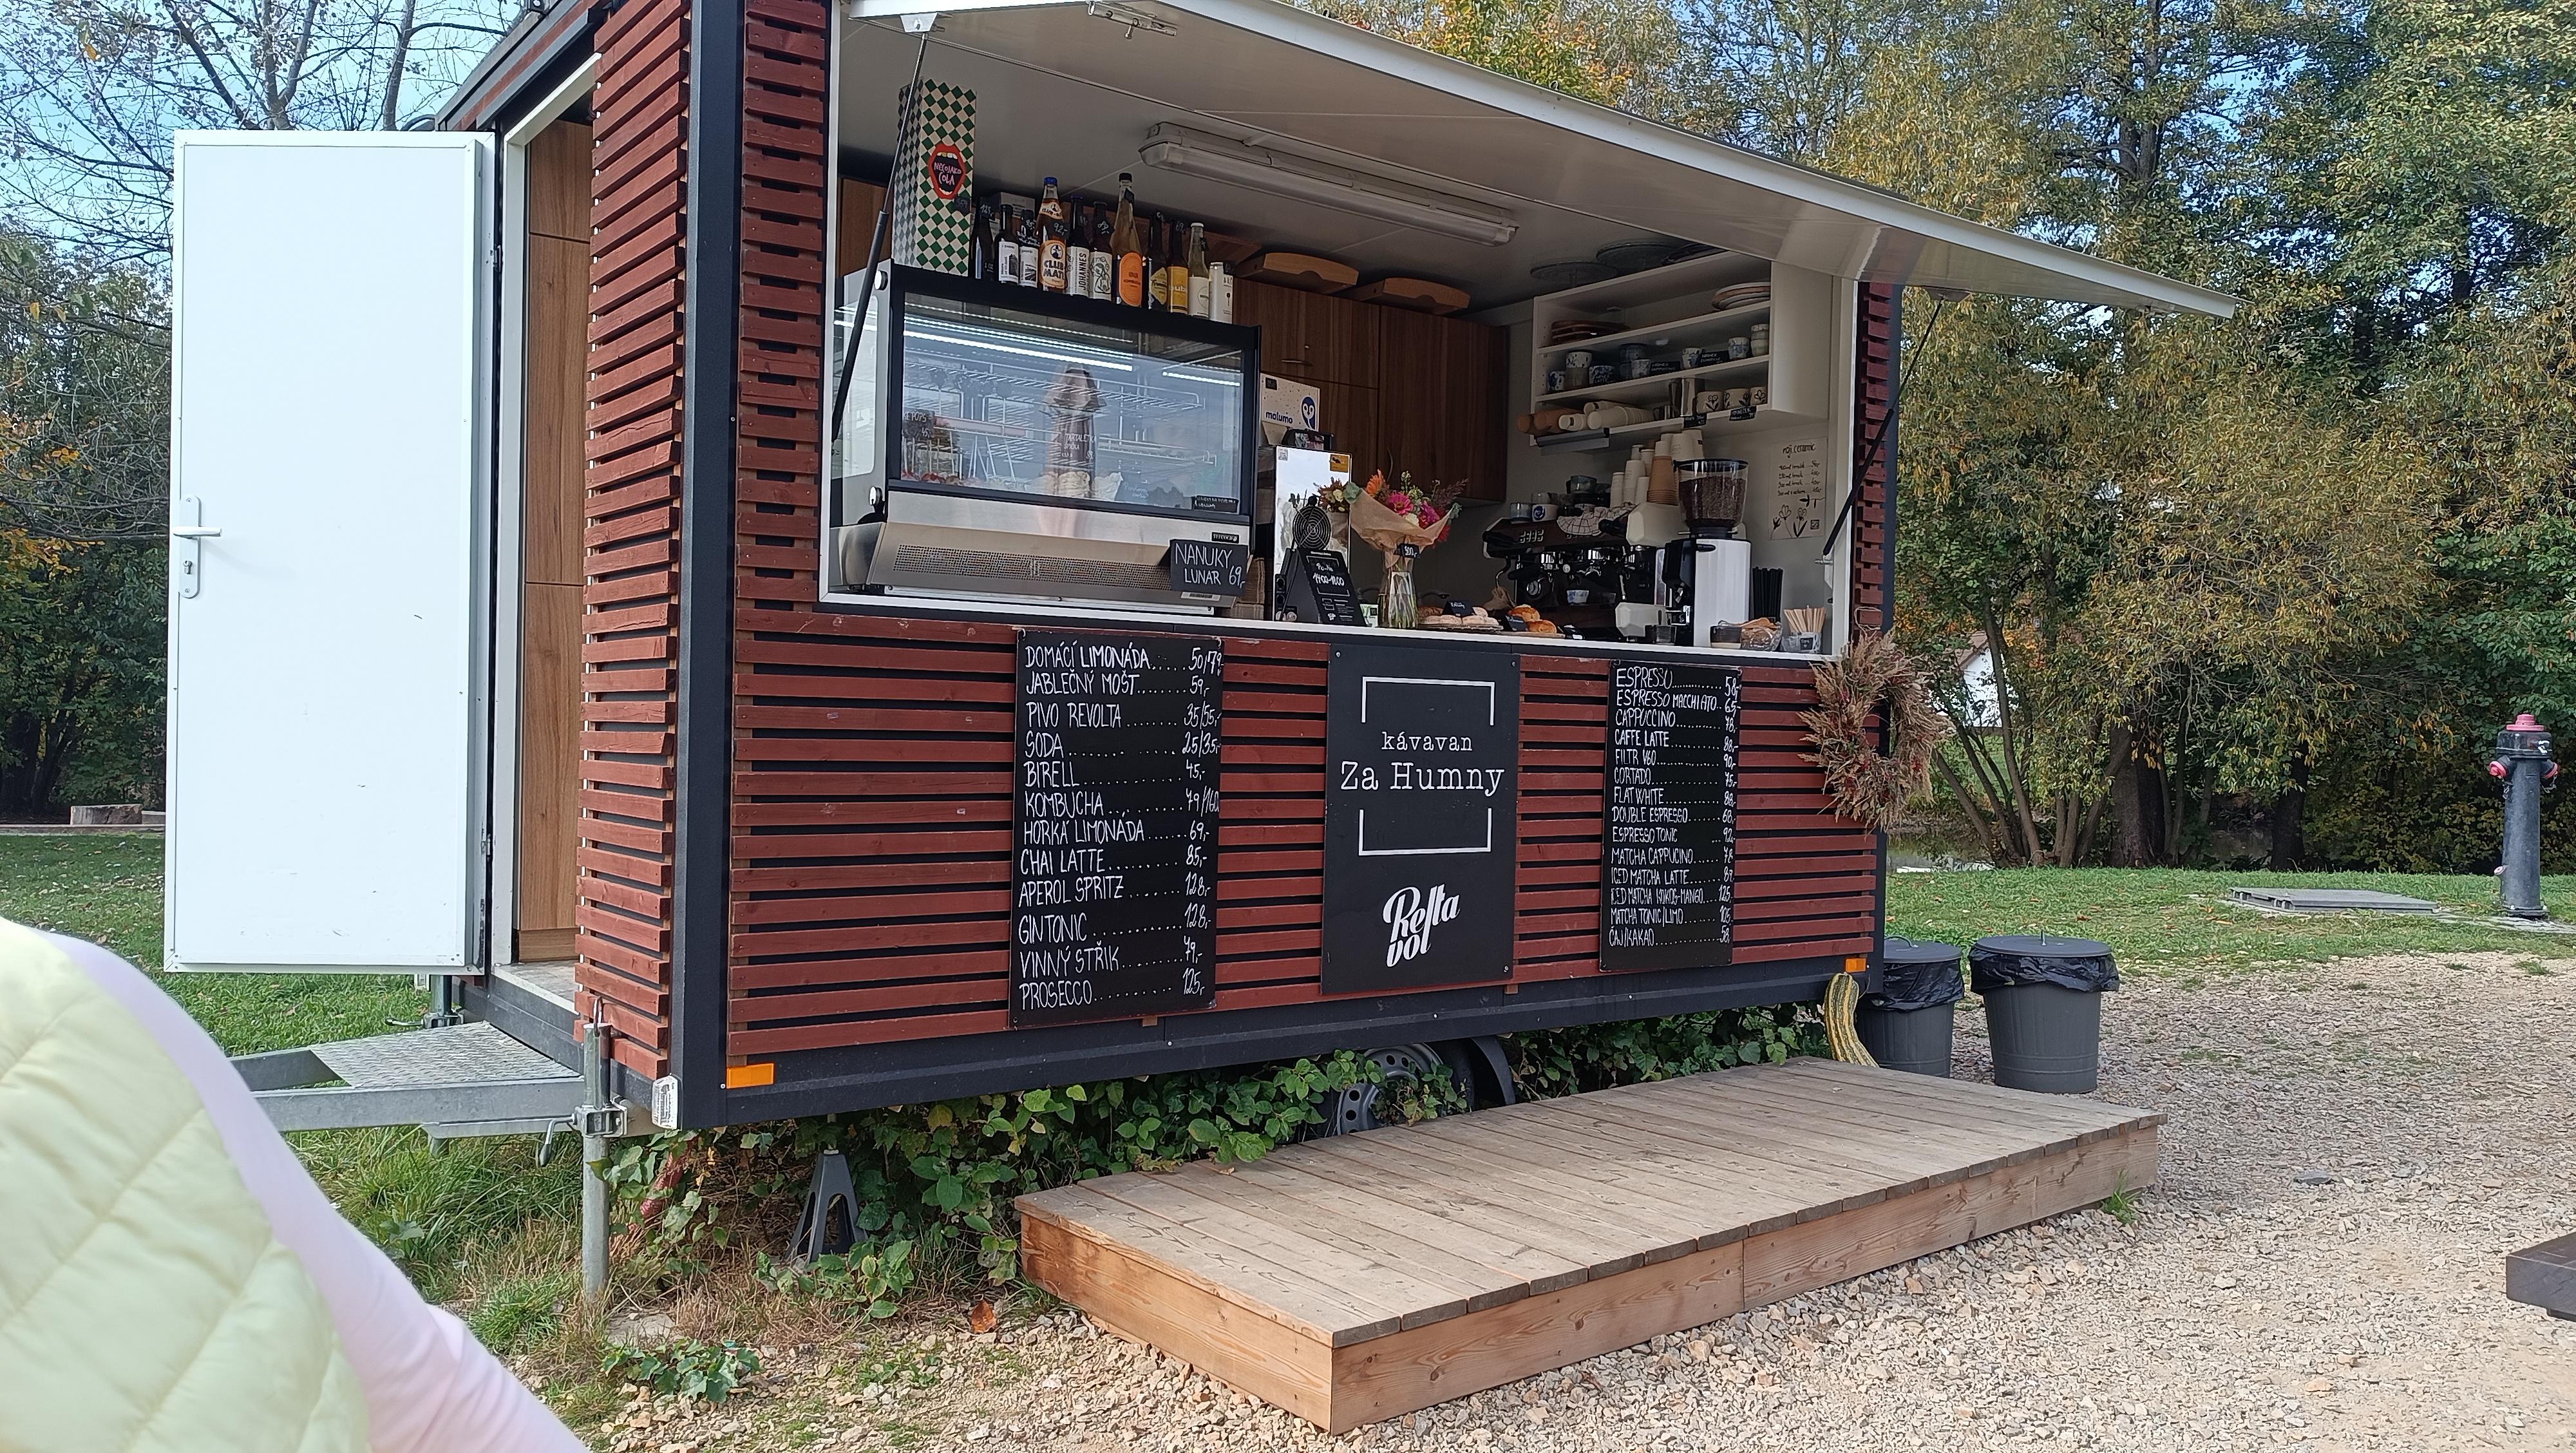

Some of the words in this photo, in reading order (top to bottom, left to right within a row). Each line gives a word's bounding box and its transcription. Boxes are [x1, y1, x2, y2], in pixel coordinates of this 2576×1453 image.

[938, 172, 954, 185] COLA
[1043, 260, 1064, 269] CLUB
[1079, 252, 1087, 291] JOHANNES
[1175, 543, 1233, 569] NANUKY
[1184, 568, 1222, 585] LUNAR
[1229, 565, 1246, 589] 69,-
[1025, 640, 1077, 668] DOMÁCÍ
[1080, 641, 1151, 670] LIMONÁDA
[1026, 669, 1095, 695] JABLEČNÝ
[1102, 670, 1140, 695] MOŠT
[1616, 666, 1673, 689] ESPRESSO
[1616, 689, 1671, 707] ESPRESSO
[1672, 694, 1718, 712] MACCHIATO
[1026, 702, 1059, 728] PIVO
[1067, 703, 1121, 728] REVOLTA
[1615, 707, 1676, 727] CAPPUCCINO
[1025, 730, 1064, 758] SODA
[1381, 731, 1473, 752] kávavan
[1615, 728, 1642, 746] CAFFE
[1644, 730, 1669, 747] LATTE
[1615, 748, 1639, 765] FILTR
[1642, 749, 1656, 766] V60
[1023, 760, 1079, 788] BIRELL
[1340, 761, 1379, 791] Za
[1390, 761, 1505, 797] Humny
[1614, 767, 1651, 785] CORTADO
[1025, 790, 1104, 819] KOMBUCHA
[1614, 786, 1634, 804] FLAT
[1636, 788, 1664, 804] WHITE
[1611, 806, 1647, 823] DOUBLE
[1649, 808, 1688, 824] ESPRESSO
[1024, 819, 1070, 846] HORKÁ
[1612, 826, 1654, 843] ESPRESSO
[1656, 827, 1678, 843] TONIC
[1020, 849, 1054, 875] CHAI
[1060, 848, 1106, 875] LATTE
[1611, 847, 1647, 865] MATCHA
[1648, 848, 1694, 865] CAPPUCINO
[1611, 867, 1629, 885] ICED
[1630, 869, 1661, 886] MATCHA
[1664, 869, 1690, 885] LATTE
[1018, 880, 1072, 908] APEROL
[1075, 875, 1124, 902] SPRITZ
[1628, 887, 1653, 905] MATCHA
[1611, 907, 1638, 925] MATCHA
[1019, 945, 1071, 979] VINNÝ
[1075, 940, 1119, 974] STŘIK
[1019, 980, 1093, 1010] PROSECCO
